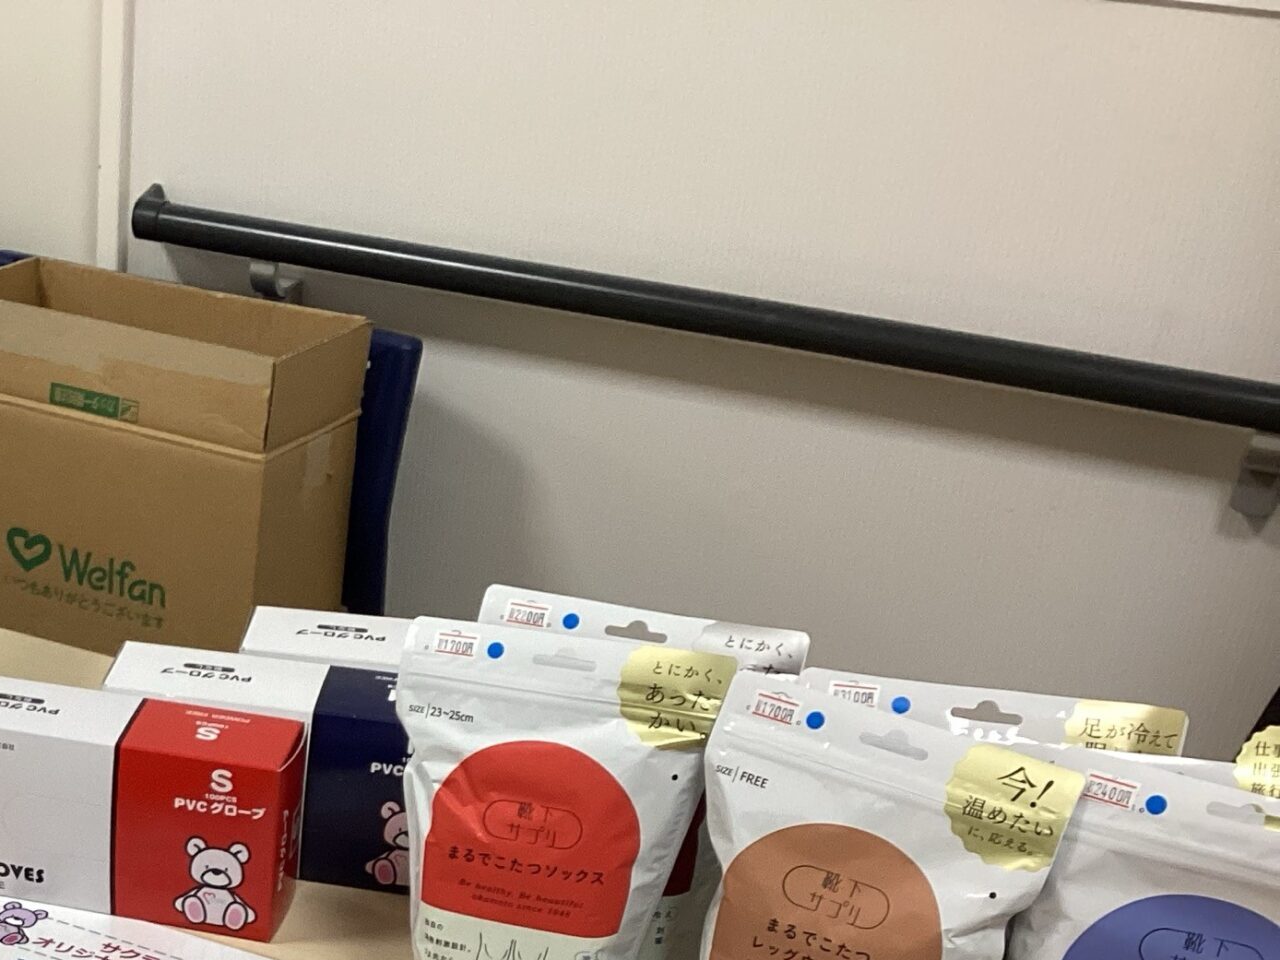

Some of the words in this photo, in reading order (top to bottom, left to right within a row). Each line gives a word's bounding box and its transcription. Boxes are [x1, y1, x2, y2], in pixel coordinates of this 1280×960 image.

[58, 544, 166, 610] Welfan
[652, 661, 724, 685] とにかく、
[409, 704, 425, 715] SIZE
[645, 683, 711, 712] あった
[195, 726, 220, 741] S
[648, 712, 696, 733] かい
[1081, 717, 1178, 750] 足が冷えて
[211, 769, 233, 793] S
[715, 764, 734, 778] SIZE
[739, 770, 769, 790] FREE
[205, 793, 237, 803] 100PCS
[962, 795, 1054, 838] 温めたい
[506, 822, 558, 847] サプリ
[967, 825, 1034, 857] に、応える。
[448, 846, 604, 886] まるでこたつソックス
[822, 872, 862, 898] 靴下
[809, 891, 862, 926] サプリ
[1183, 932, 1231, 956] 靴下
